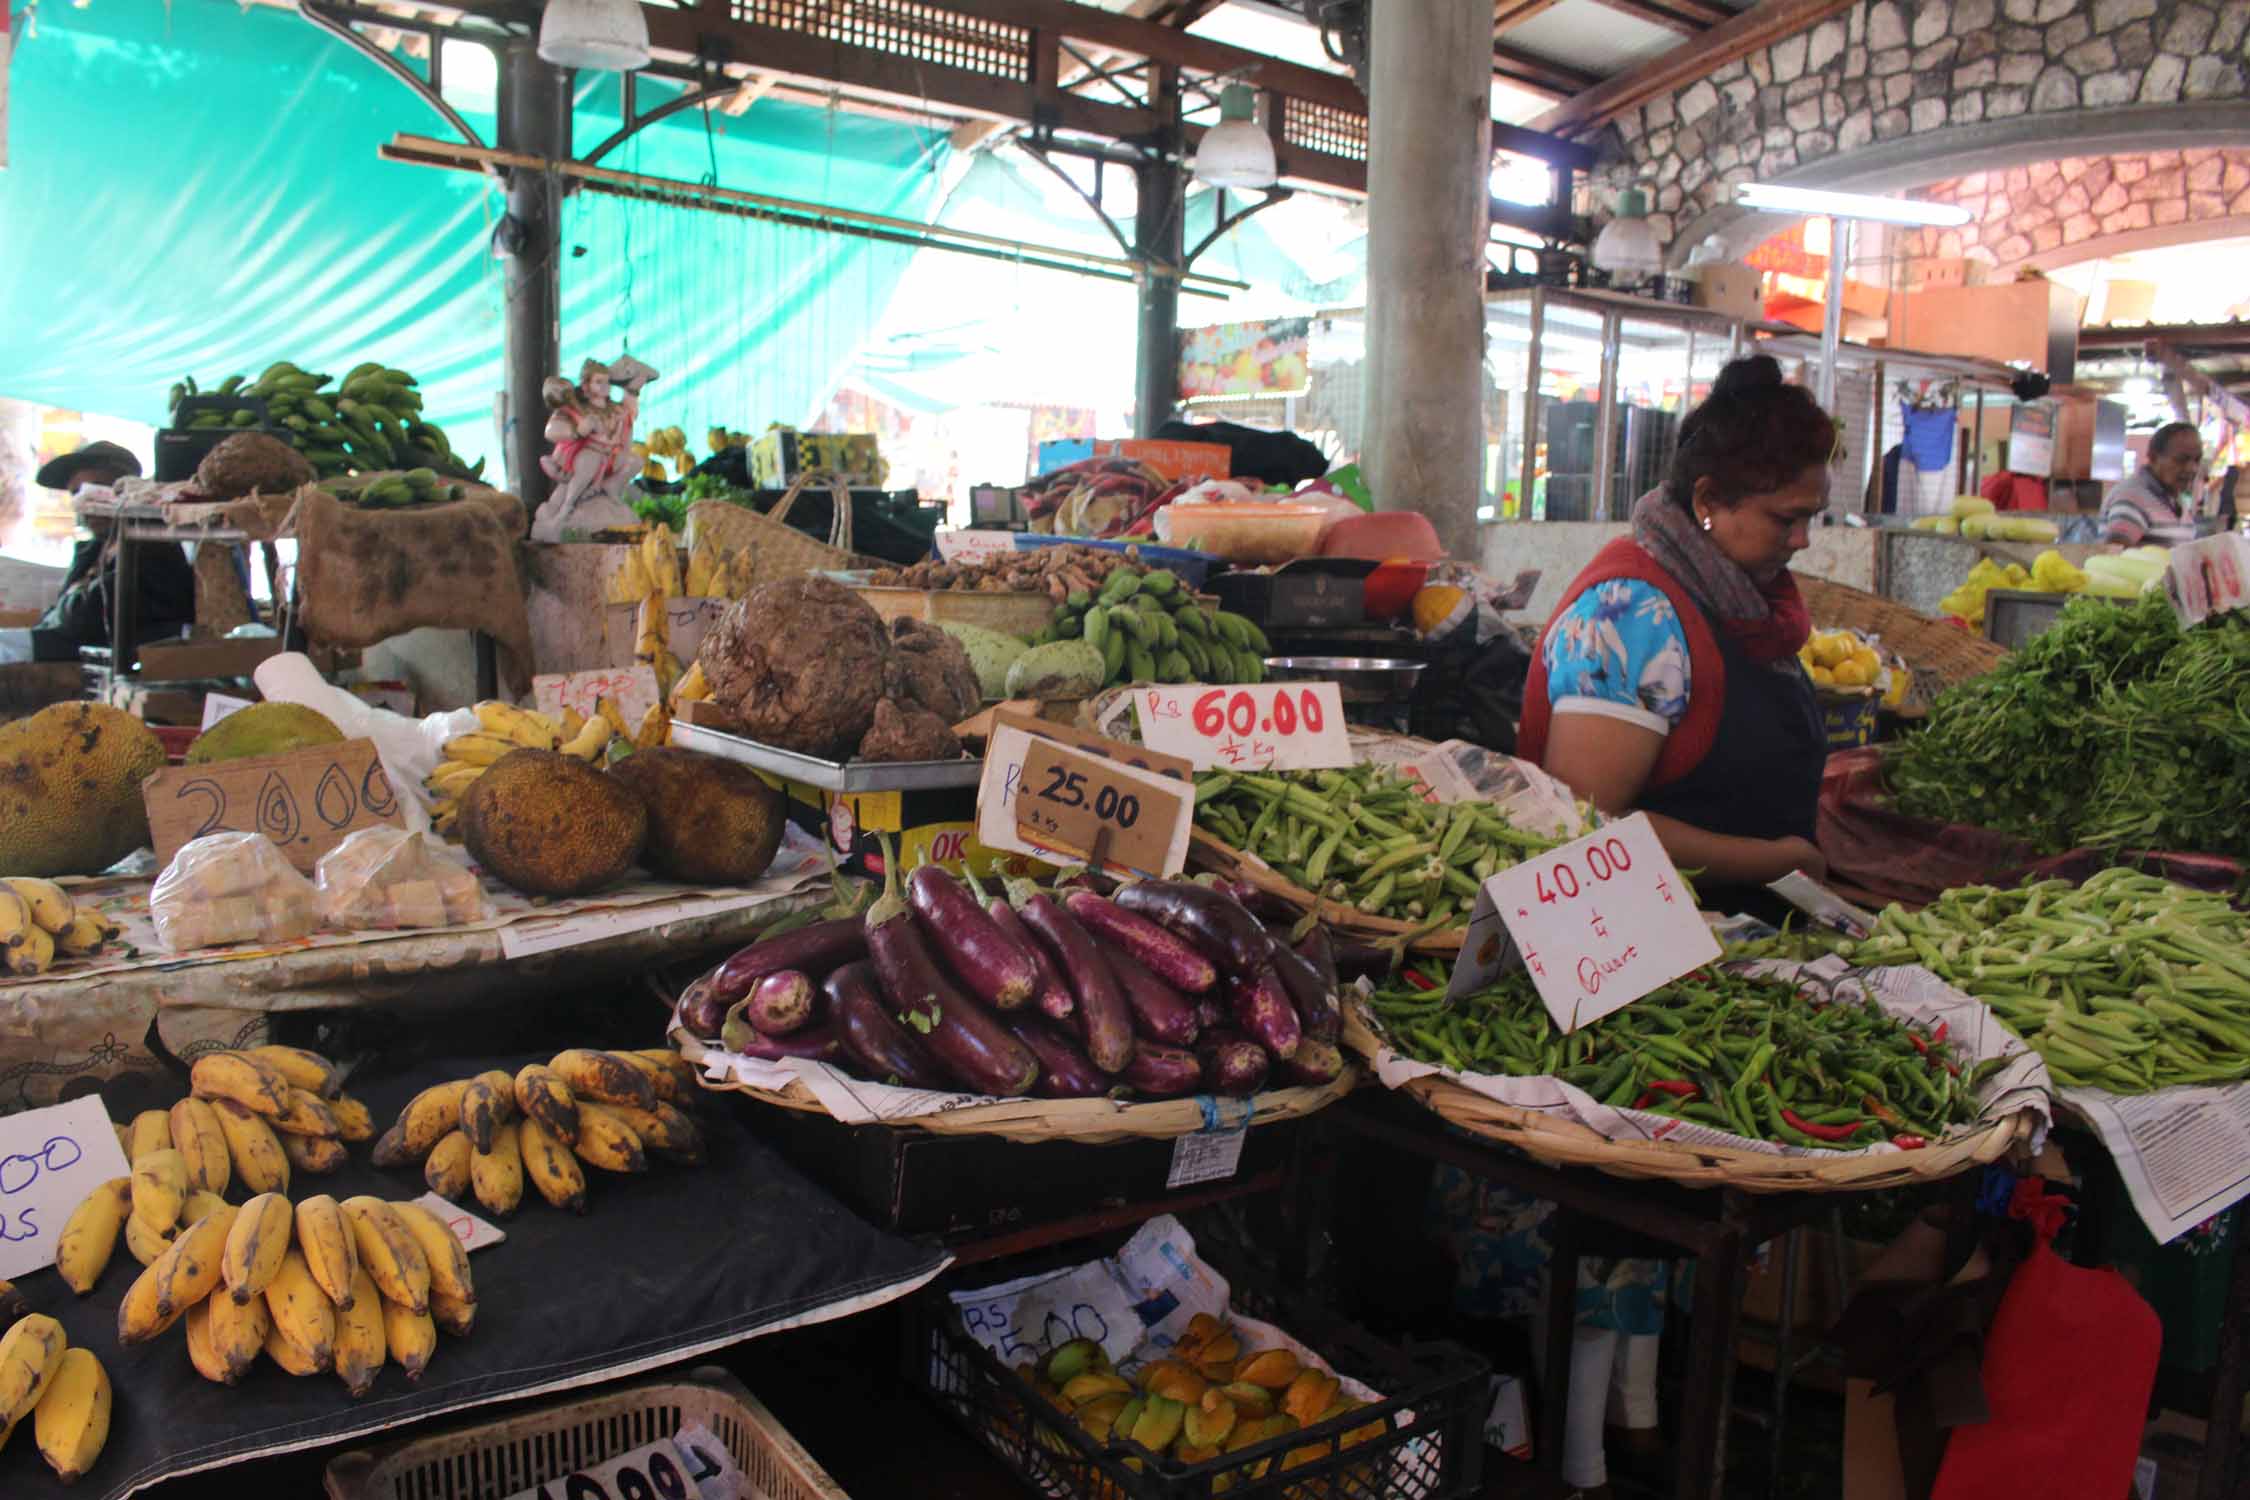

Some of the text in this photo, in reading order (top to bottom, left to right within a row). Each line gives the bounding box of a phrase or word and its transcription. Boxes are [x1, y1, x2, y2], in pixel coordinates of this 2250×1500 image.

[1192, 688, 1324, 737] 60.00
[1038, 765, 1140, 829] 25.00
[931, 832, 969, 864] OK
[1536, 838, 1632, 905] 40.00
[1576, 944, 1638, 994] Quart
